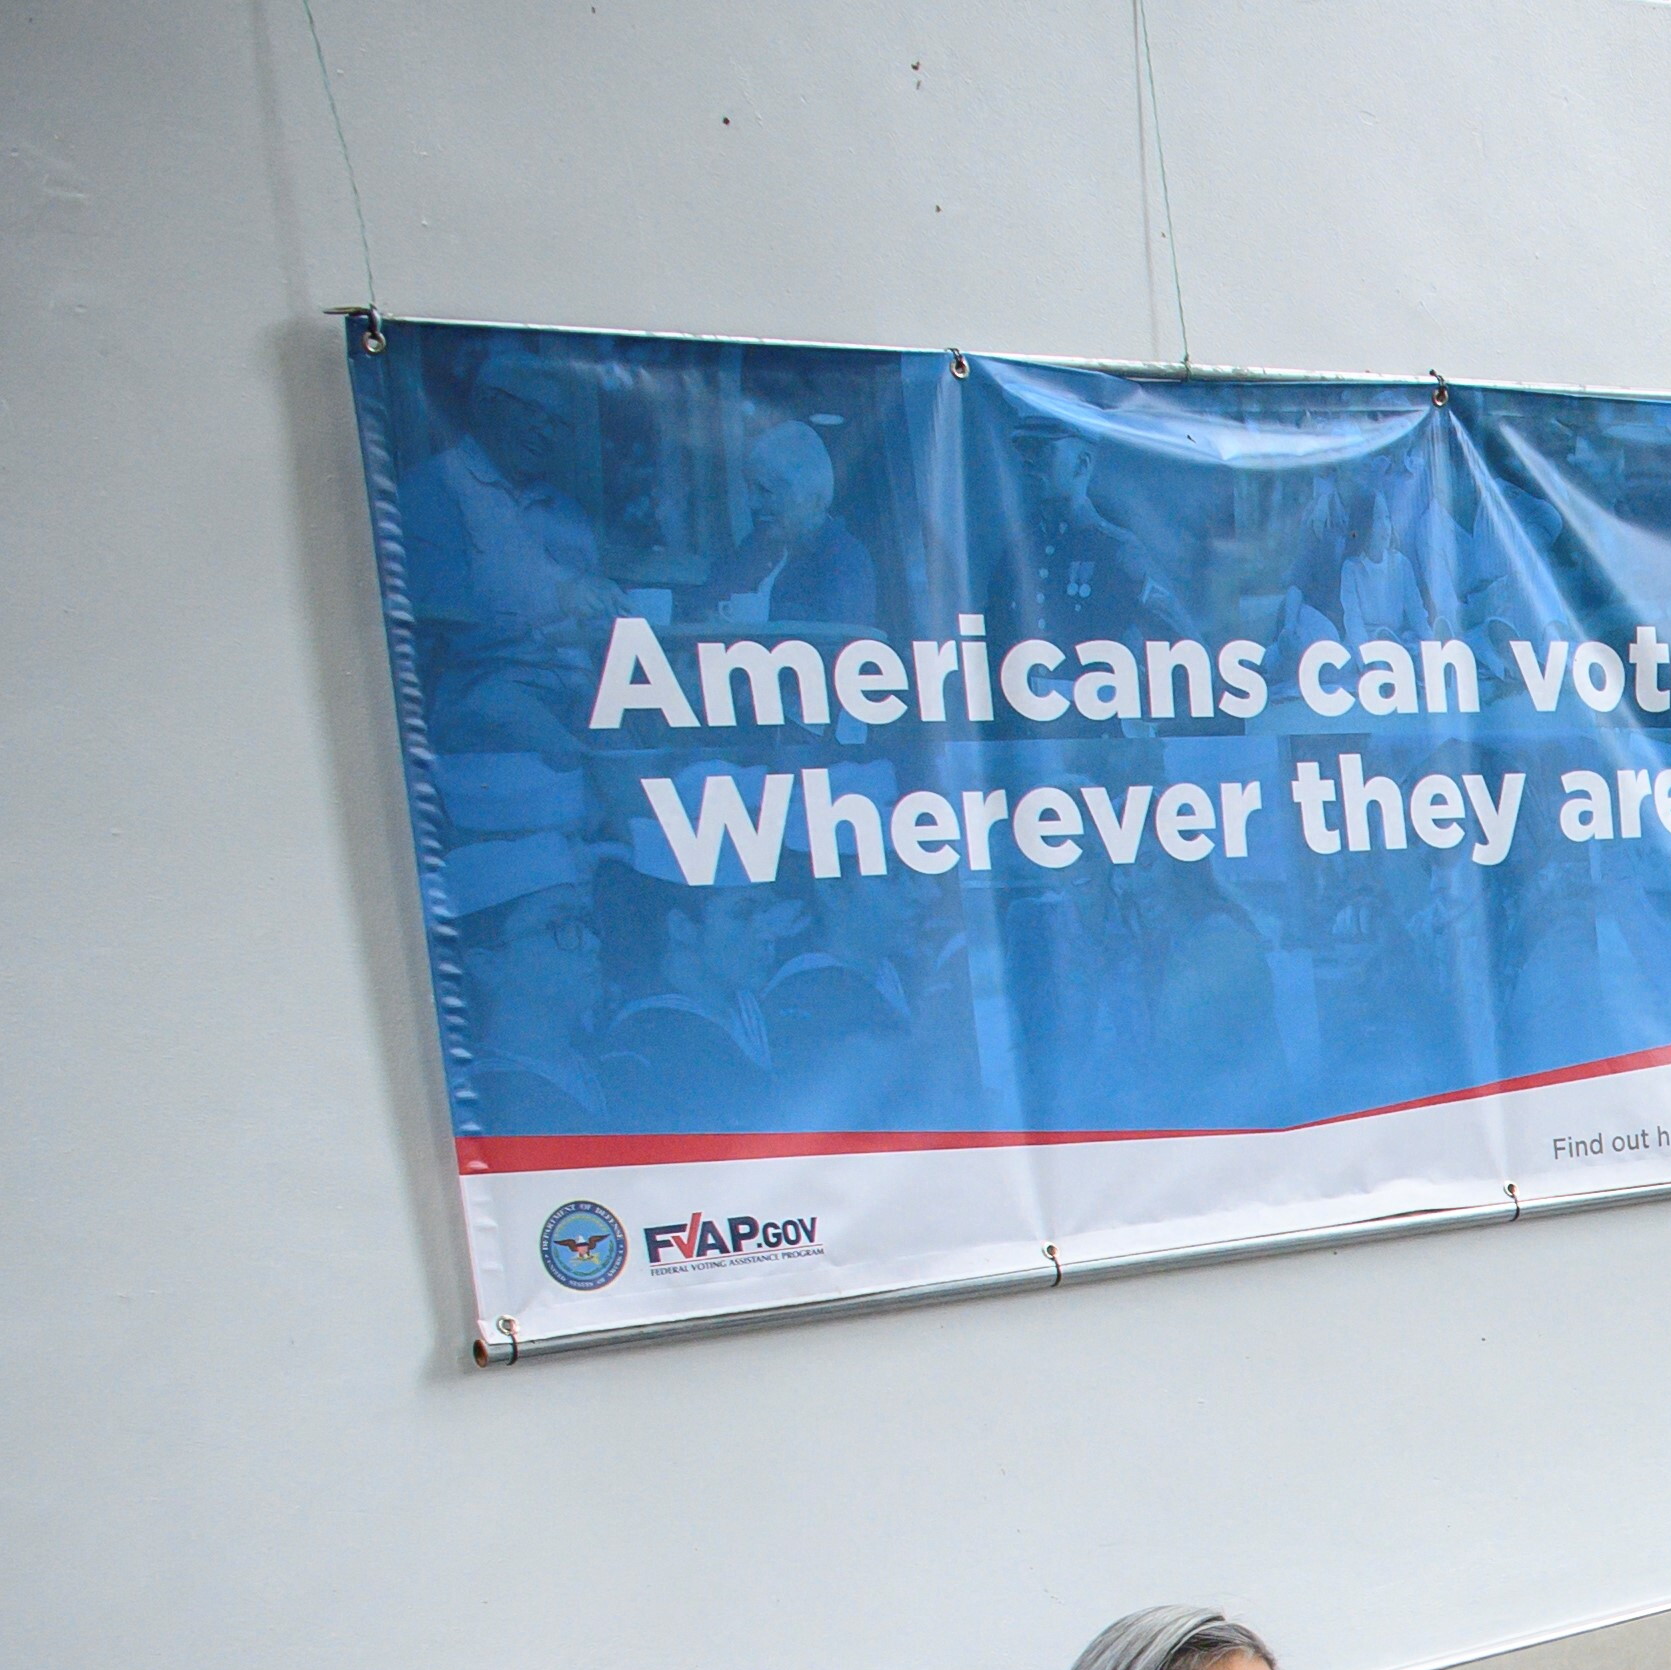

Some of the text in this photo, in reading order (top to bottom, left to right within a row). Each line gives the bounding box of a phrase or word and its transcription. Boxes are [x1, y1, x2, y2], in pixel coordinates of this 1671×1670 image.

[589, 613, 1268, 730] Americans
[1299, 639, 1480, 717] can
[640, 768, 1262, 886] Wherever
[1292, 754, 1526, 866] they
[1552, 1132, 1604, 1160] Find
[1612, 1128, 1650, 1152] out
[651, 1248, 825, 1277] FEDERAL VOTING ASSISTANCE PROGRAM
